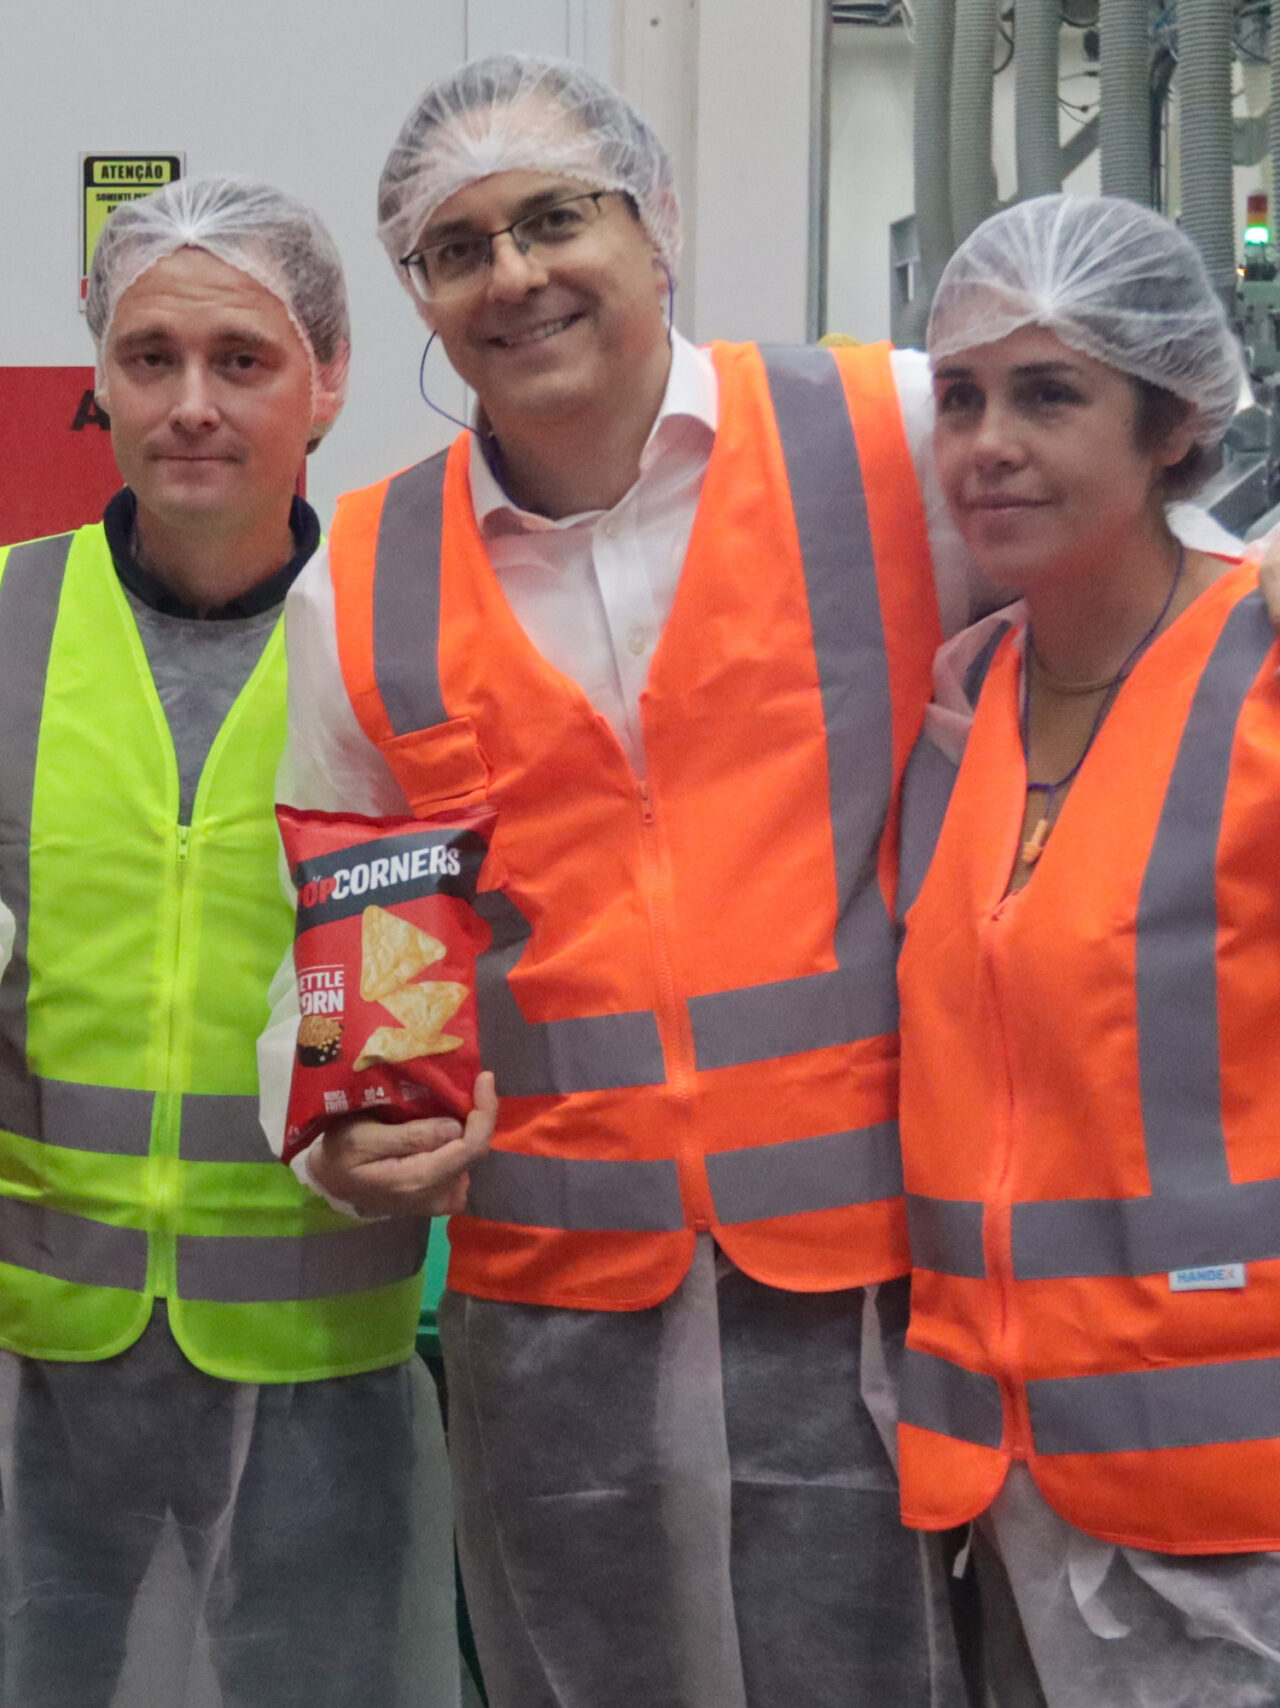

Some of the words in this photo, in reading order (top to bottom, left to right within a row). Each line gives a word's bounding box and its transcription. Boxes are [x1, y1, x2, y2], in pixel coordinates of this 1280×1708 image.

[101, 162, 163, 182] ATENÇÃO
[96, 192, 131, 202] SOMENTE
[297, 845, 460, 908] OPCORNERS
[299, 970, 344, 992] ETTLE
[300, 989, 344, 1016] ORN
